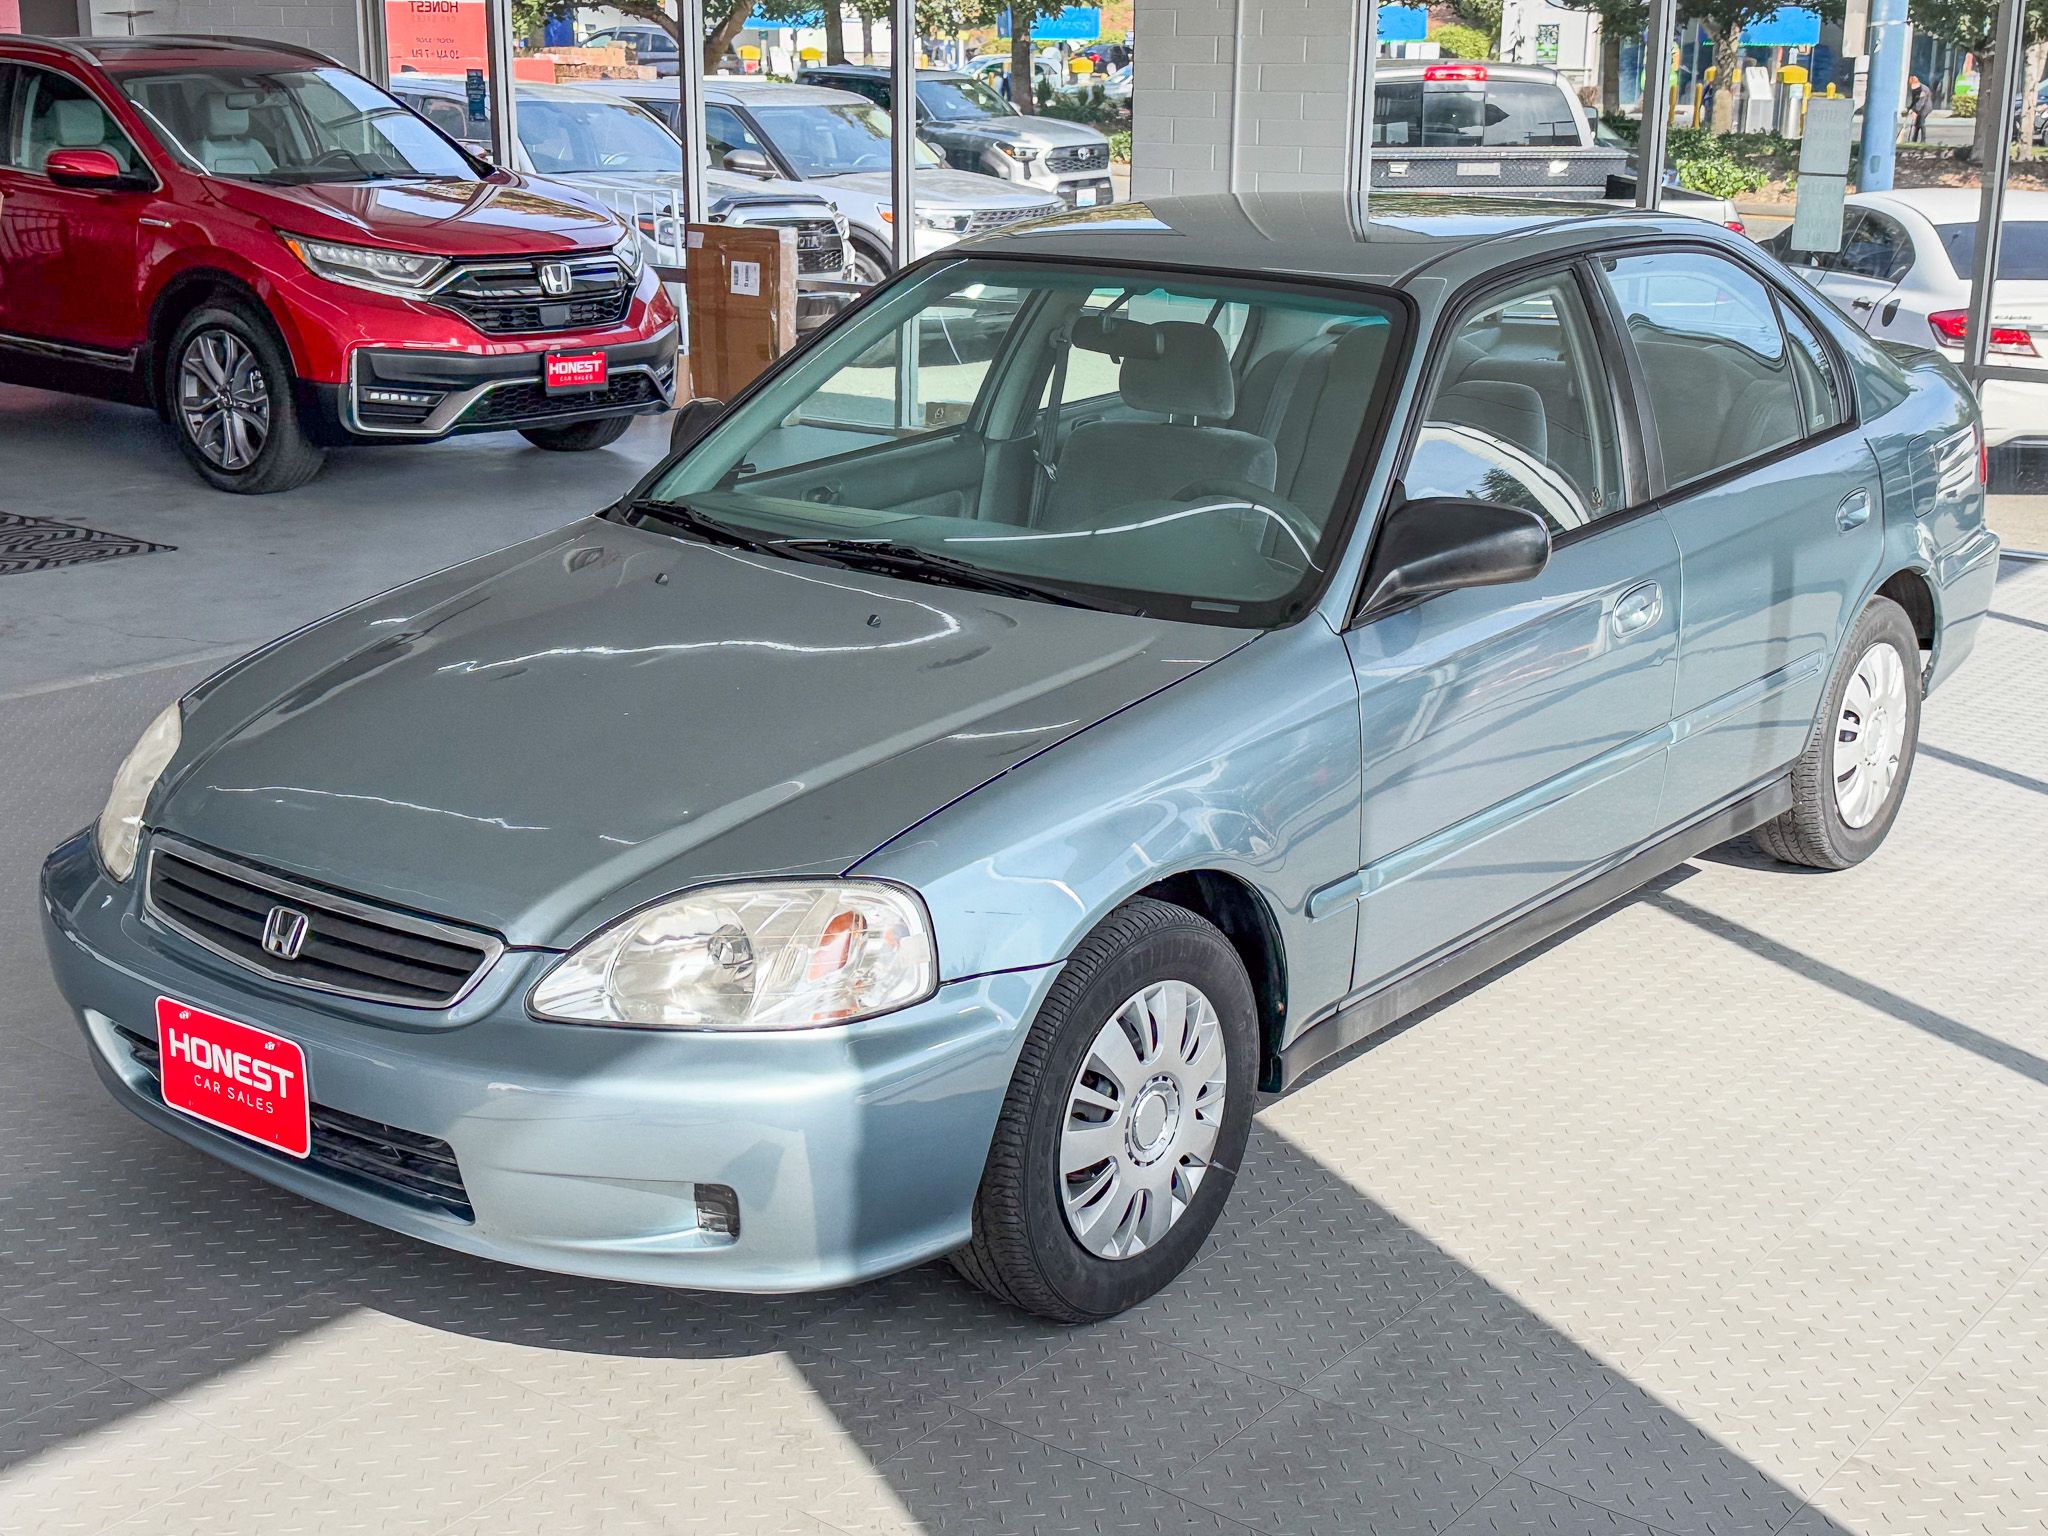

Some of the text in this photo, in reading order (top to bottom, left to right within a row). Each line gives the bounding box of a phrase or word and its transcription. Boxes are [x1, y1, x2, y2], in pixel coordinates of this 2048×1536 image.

[798, 235, 819, 248] OTA
[548, 360, 603, 375] HONEST
[168, 1027, 294, 1099] HONEST
[194, 1074, 274, 1114] CAR SALES
